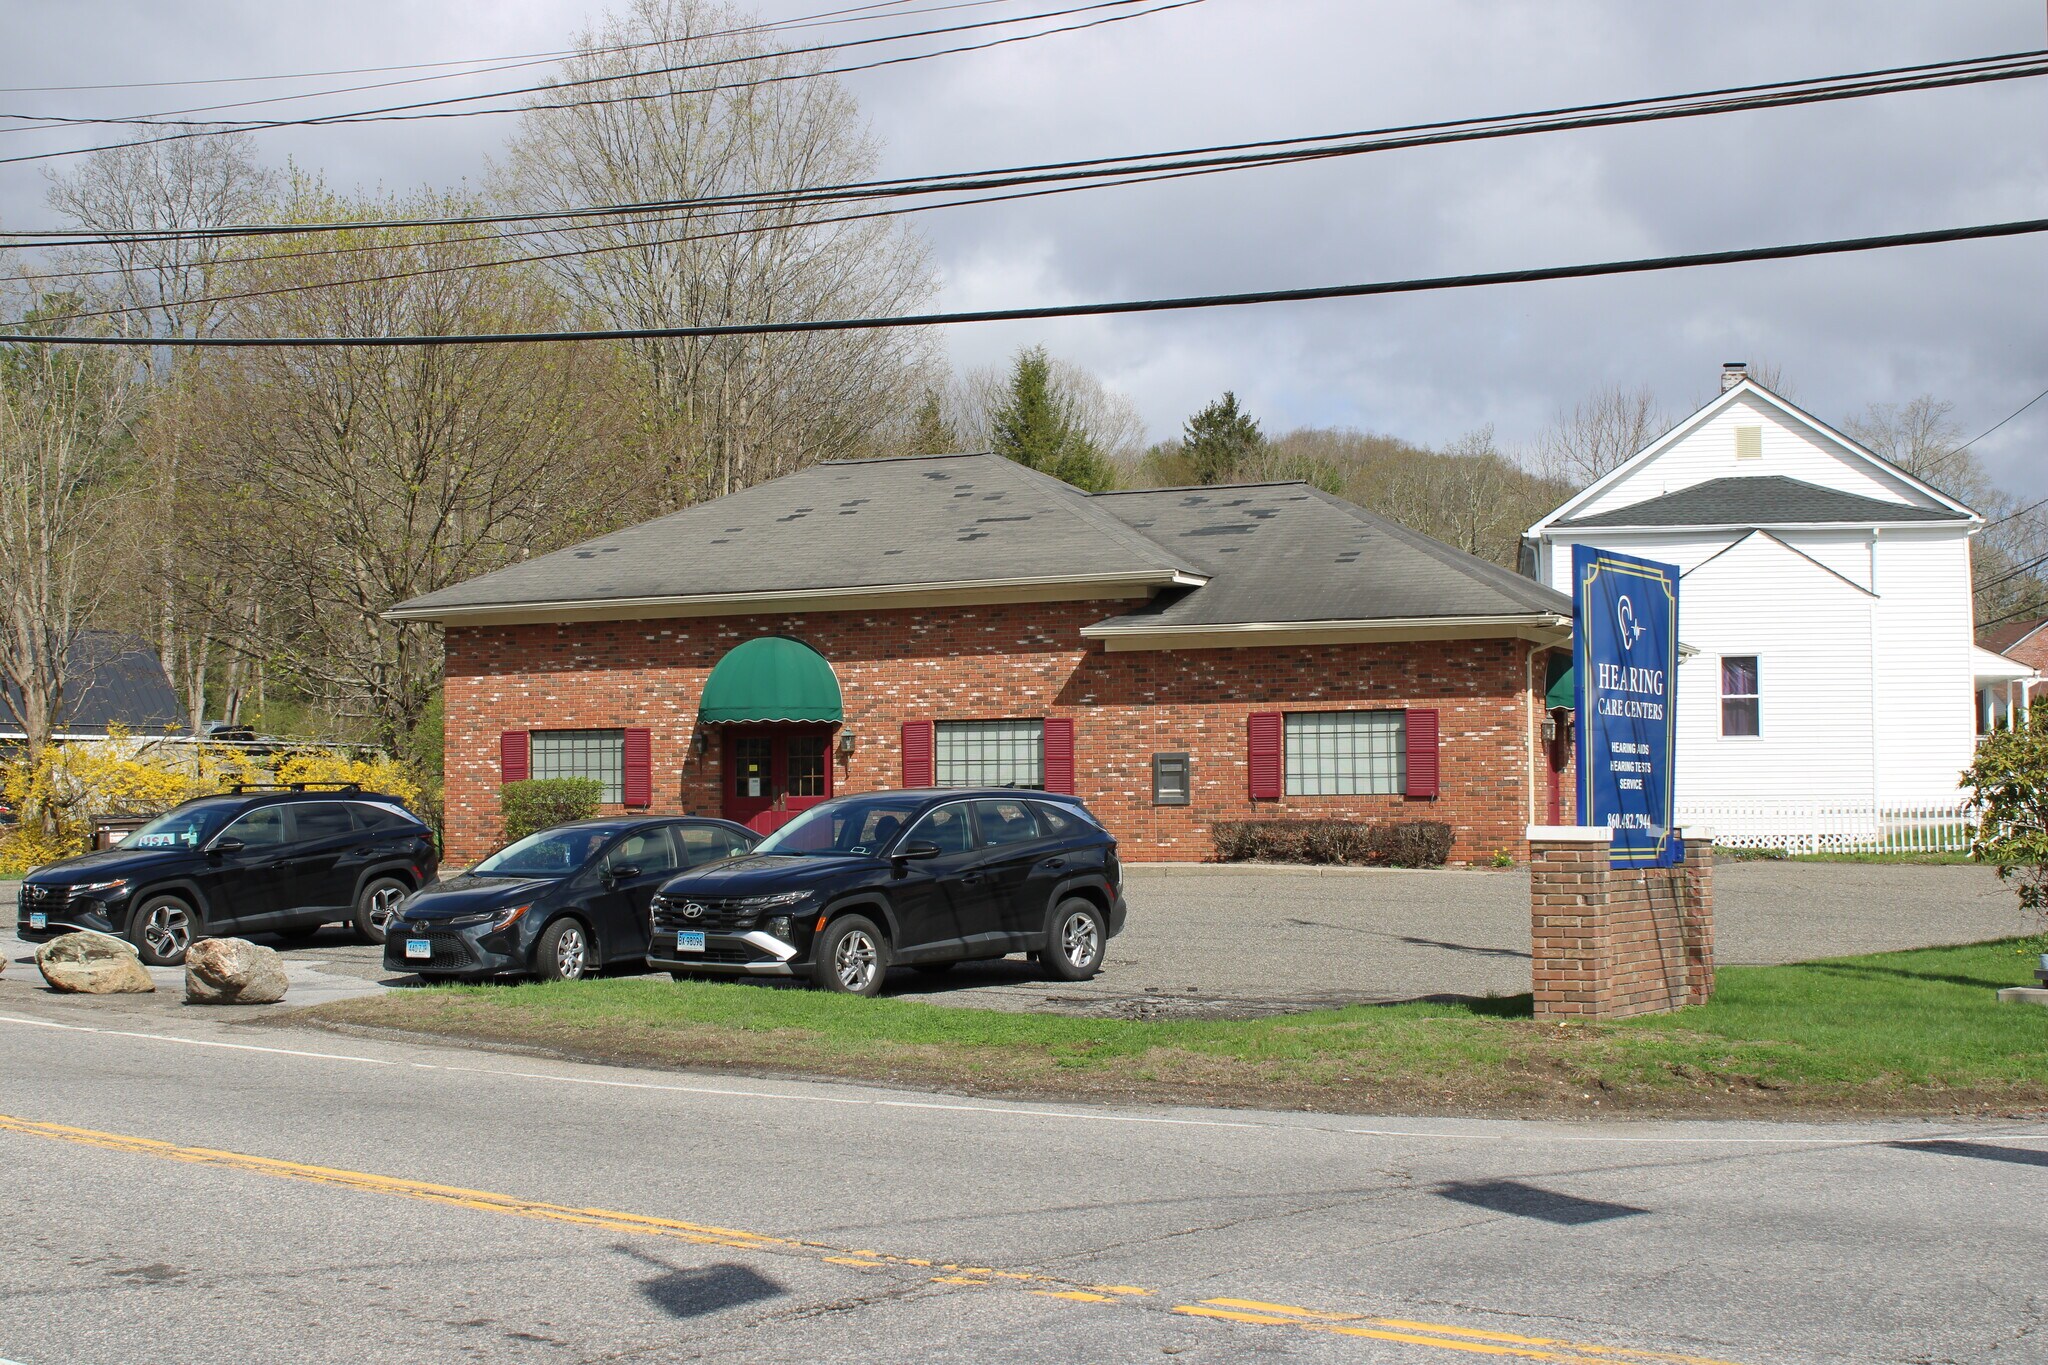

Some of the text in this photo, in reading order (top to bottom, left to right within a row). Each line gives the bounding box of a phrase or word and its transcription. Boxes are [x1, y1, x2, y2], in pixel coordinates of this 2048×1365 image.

[1598, 663, 1663, 696] HEARING
[1598, 697, 1663, 721] CARE CENTERS
[1611, 741, 1650, 755] HEARING AIDS
[1610, 760, 1651, 774] HEARING TESTS
[1619, 778, 1643, 790] SERVICE
[1607, 813, 1651, 829] 860.482.7944
